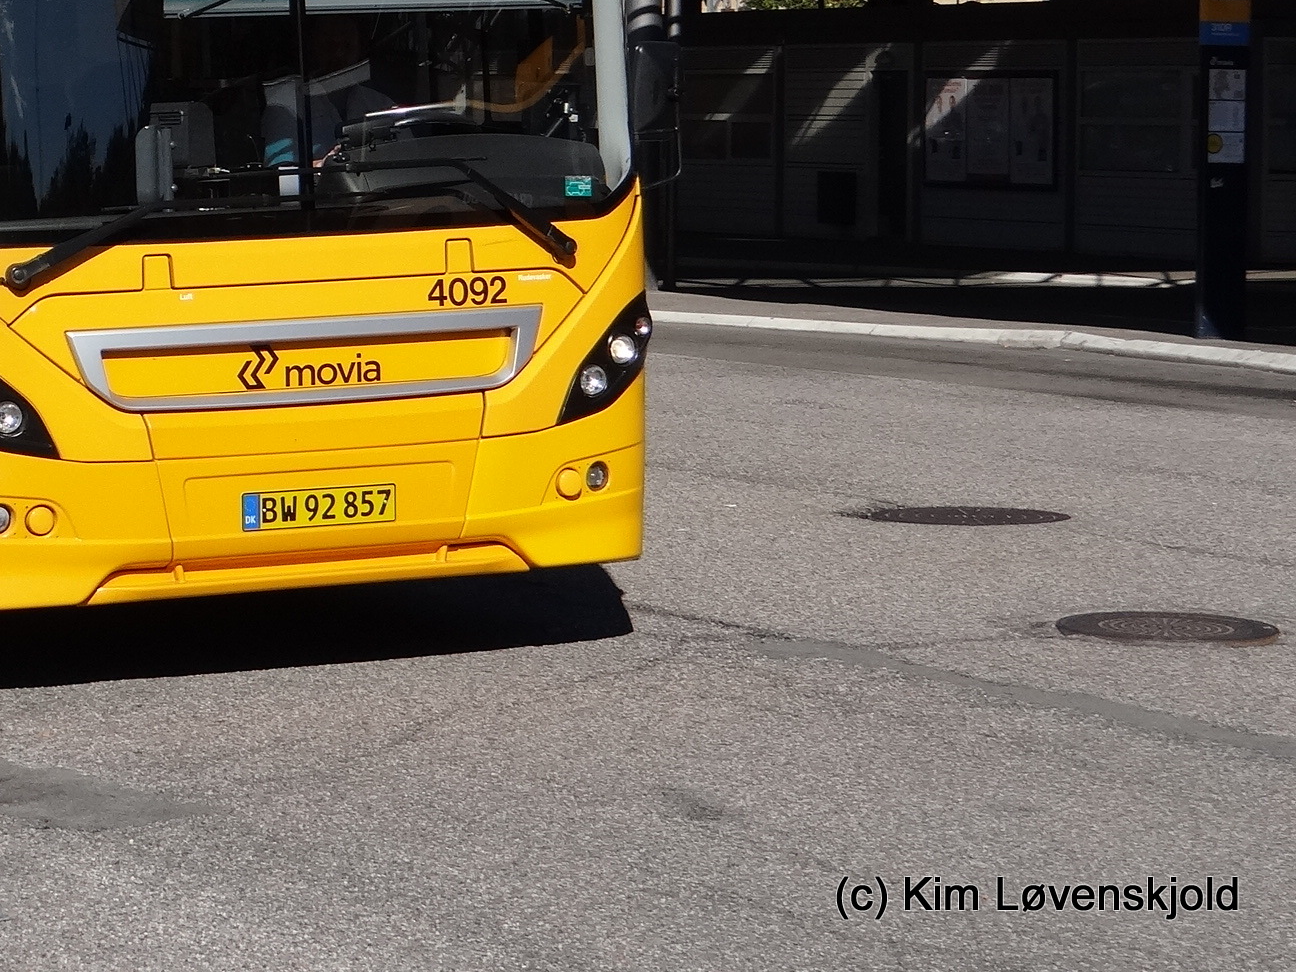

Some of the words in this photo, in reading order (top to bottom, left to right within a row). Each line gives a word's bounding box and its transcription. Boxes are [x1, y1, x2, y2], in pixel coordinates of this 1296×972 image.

[428, 275, 508, 307] 4092
[285, 353, 381, 387] movia
[245, 515, 256, 525] DK
[262, 496, 297, 523] BW
[304, 493, 336, 522] 92
[343, 489, 391, 519] 857
